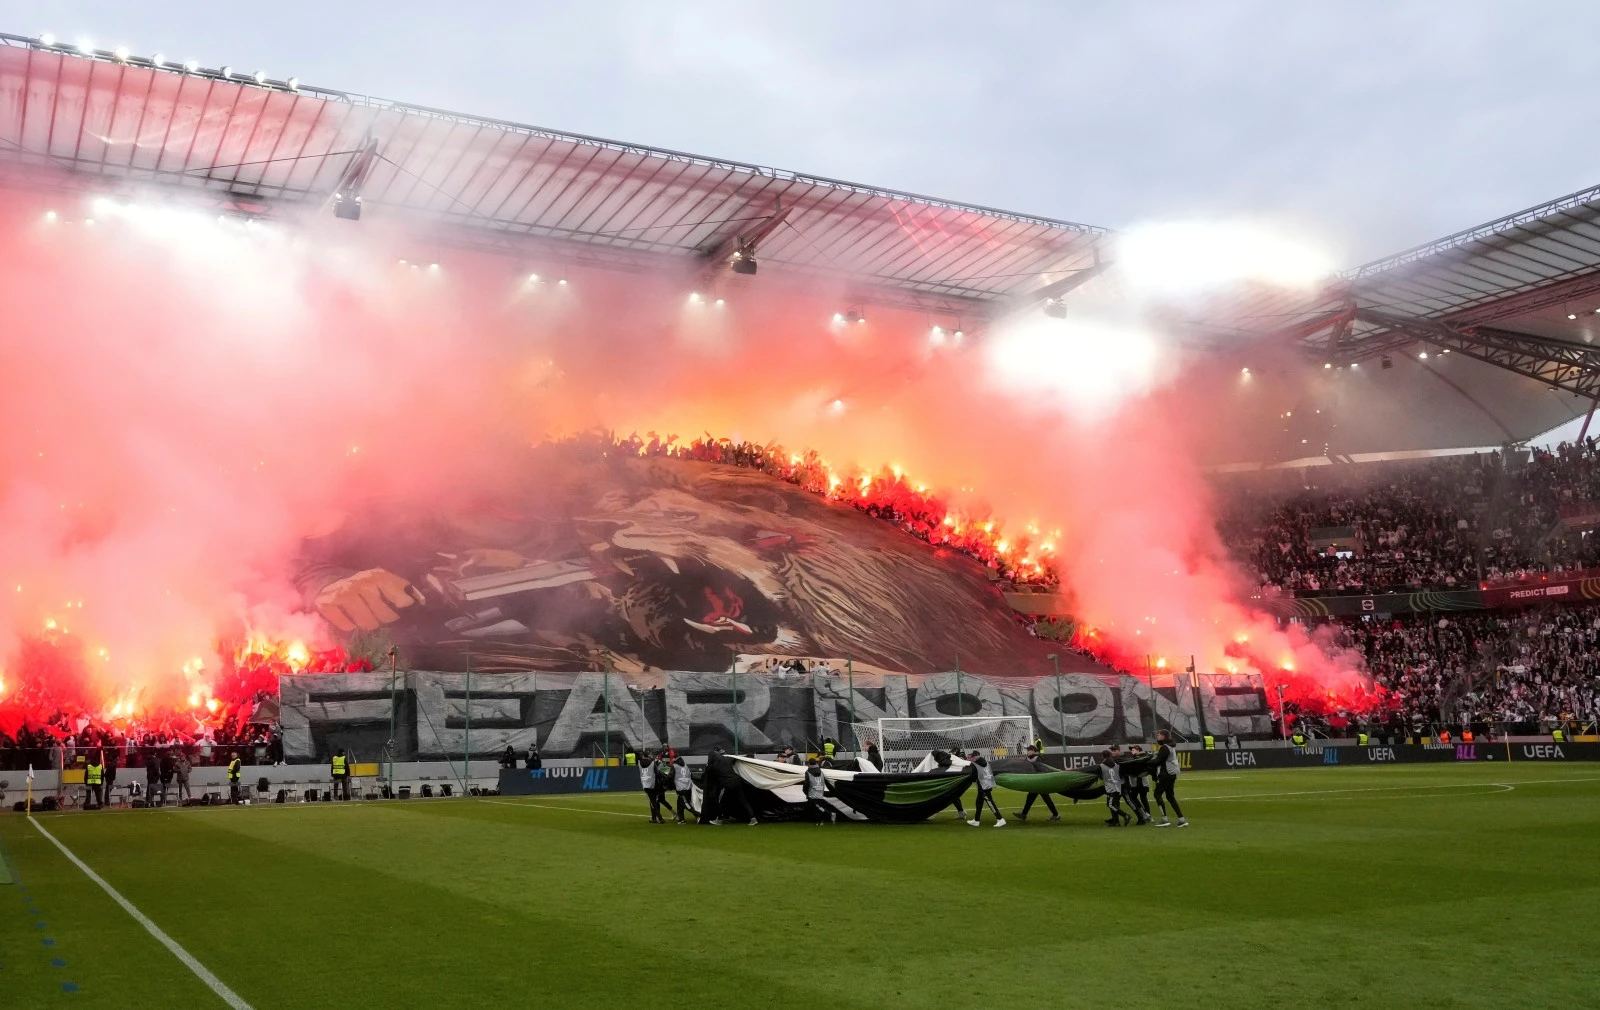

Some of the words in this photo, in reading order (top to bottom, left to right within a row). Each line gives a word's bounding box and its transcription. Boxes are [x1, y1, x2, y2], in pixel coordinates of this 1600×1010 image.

[1510, 588, 1545, 599] PREDICT
[280, 670, 776, 758] FEAR
[813, 670, 1006, 744] NO
[1032, 672, 1272, 741] ONE
[1225, 752, 1256, 766] UEFA
[1323, 748, 1339, 764] ALL
[1368, 747, 1396, 761] UEFA
[1456, 744, 1477, 760] ALL
[1523, 745, 1565, 758] UEFA
[1063, 756, 1096, 771] UEFA
[583, 768, 609, 790] ALL
